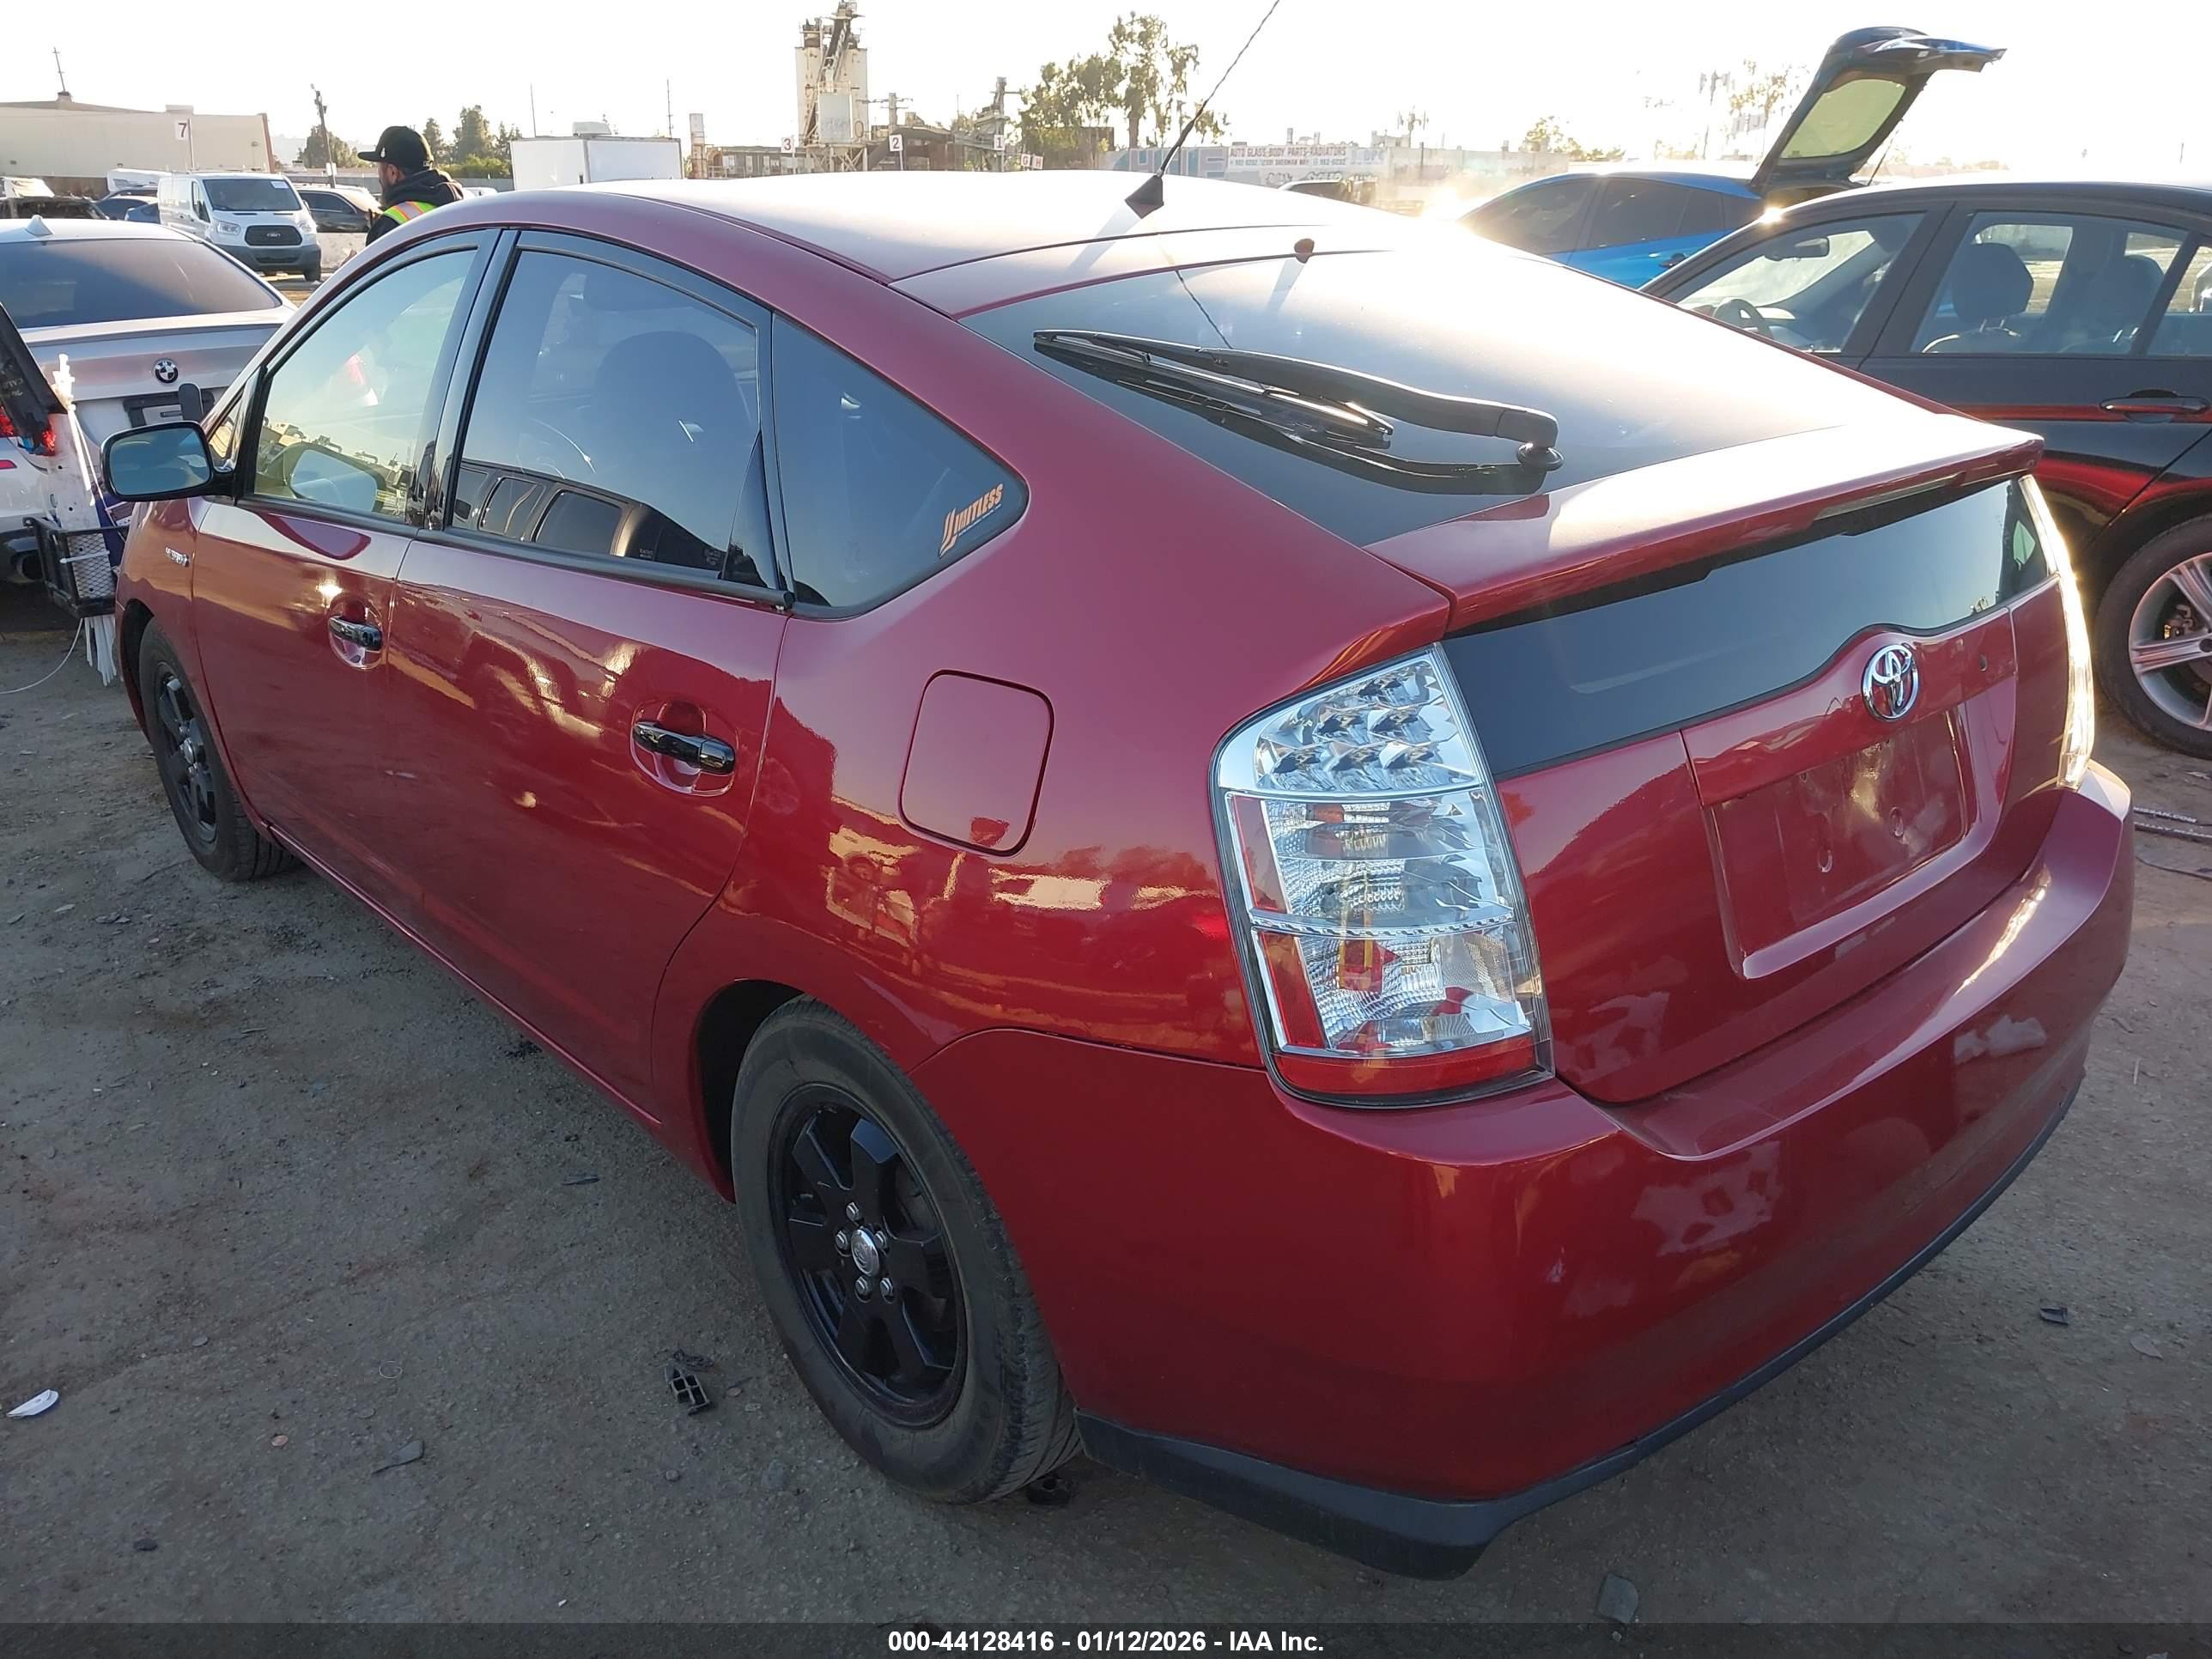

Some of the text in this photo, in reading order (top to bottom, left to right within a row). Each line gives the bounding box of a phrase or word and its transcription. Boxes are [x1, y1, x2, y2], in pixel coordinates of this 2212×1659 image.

[178, 122, 187, 137] 7
[783, 137, 792, 150] 3
[892, 137, 900, 149] 2
[996, 137, 1003, 149] 1
[1230, 147, 1245, 157] AUTO
